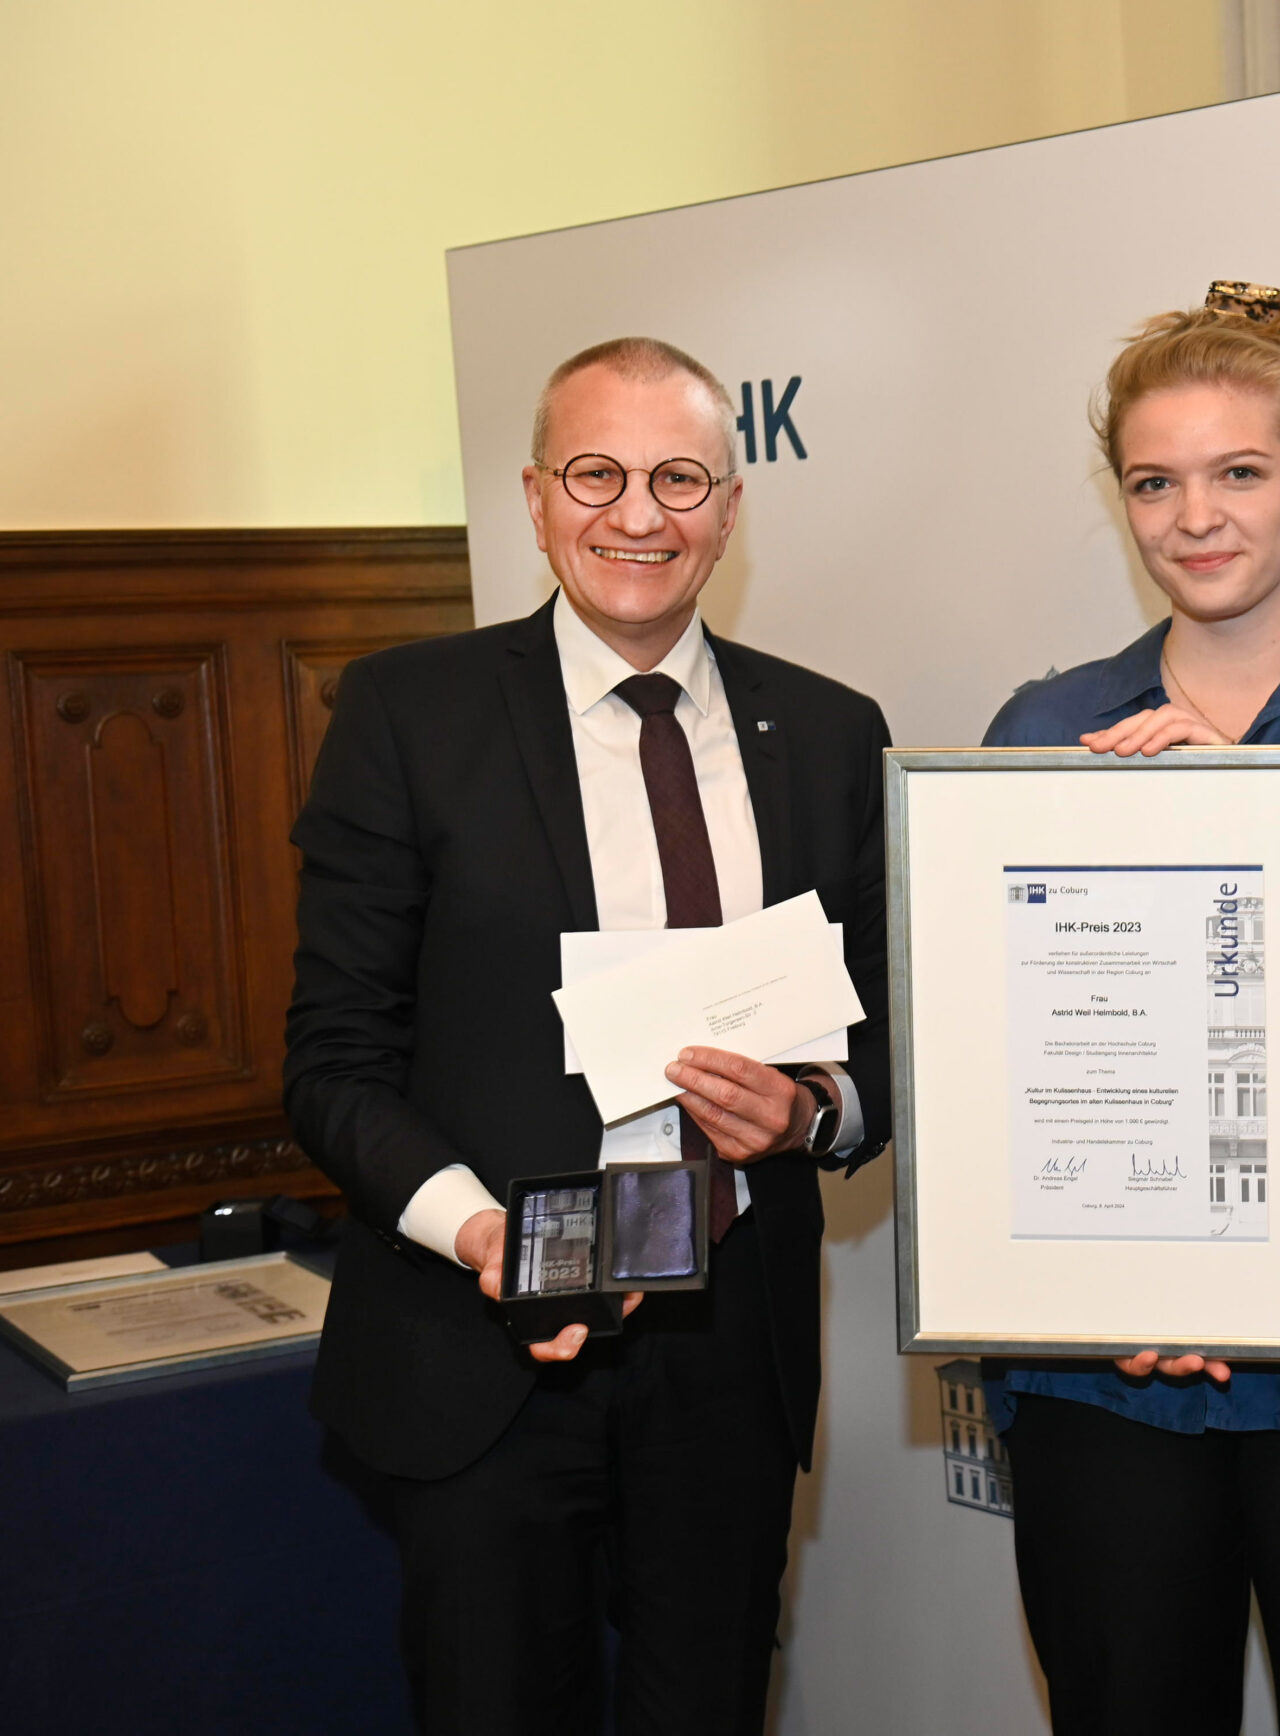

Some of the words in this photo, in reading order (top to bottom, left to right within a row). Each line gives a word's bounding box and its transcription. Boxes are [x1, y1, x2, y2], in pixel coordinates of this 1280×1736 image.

[736, 376, 808, 463] HK
[1029, 886, 1045, 895] IHK
[1048, 887, 1057, 895] zu
[1060, 886, 1088, 897] Coburg
[1055, 922, 1110, 933] IHK-Preis
[1113, 922, 1142, 933] 2023
[1213, 882, 1239, 997] Urkunde
[1052, 1009, 1073, 1017] Astrid
[1075, 1009, 1091, 1017] Weil
[1132, 1009, 1148, 1017] B.A.
[1045, 1087, 1052, 1095] im
[1053, 1087, 1092, 1095] Kulissenhaus
[1096, 1087, 1131, 1095] Entwicklung
[1132, 1087, 1148, 1095] eines
[1149, 1087, 1179, 1095] kulturellen
[1080, 1098, 1088, 1106] im
[1089, 1098, 1103, 1106] alten
[1104, 1098, 1143, 1106] Kulissenhaus
[1144, 1098, 1149, 1106] in
[566, 1216, 587, 1227] IHK
